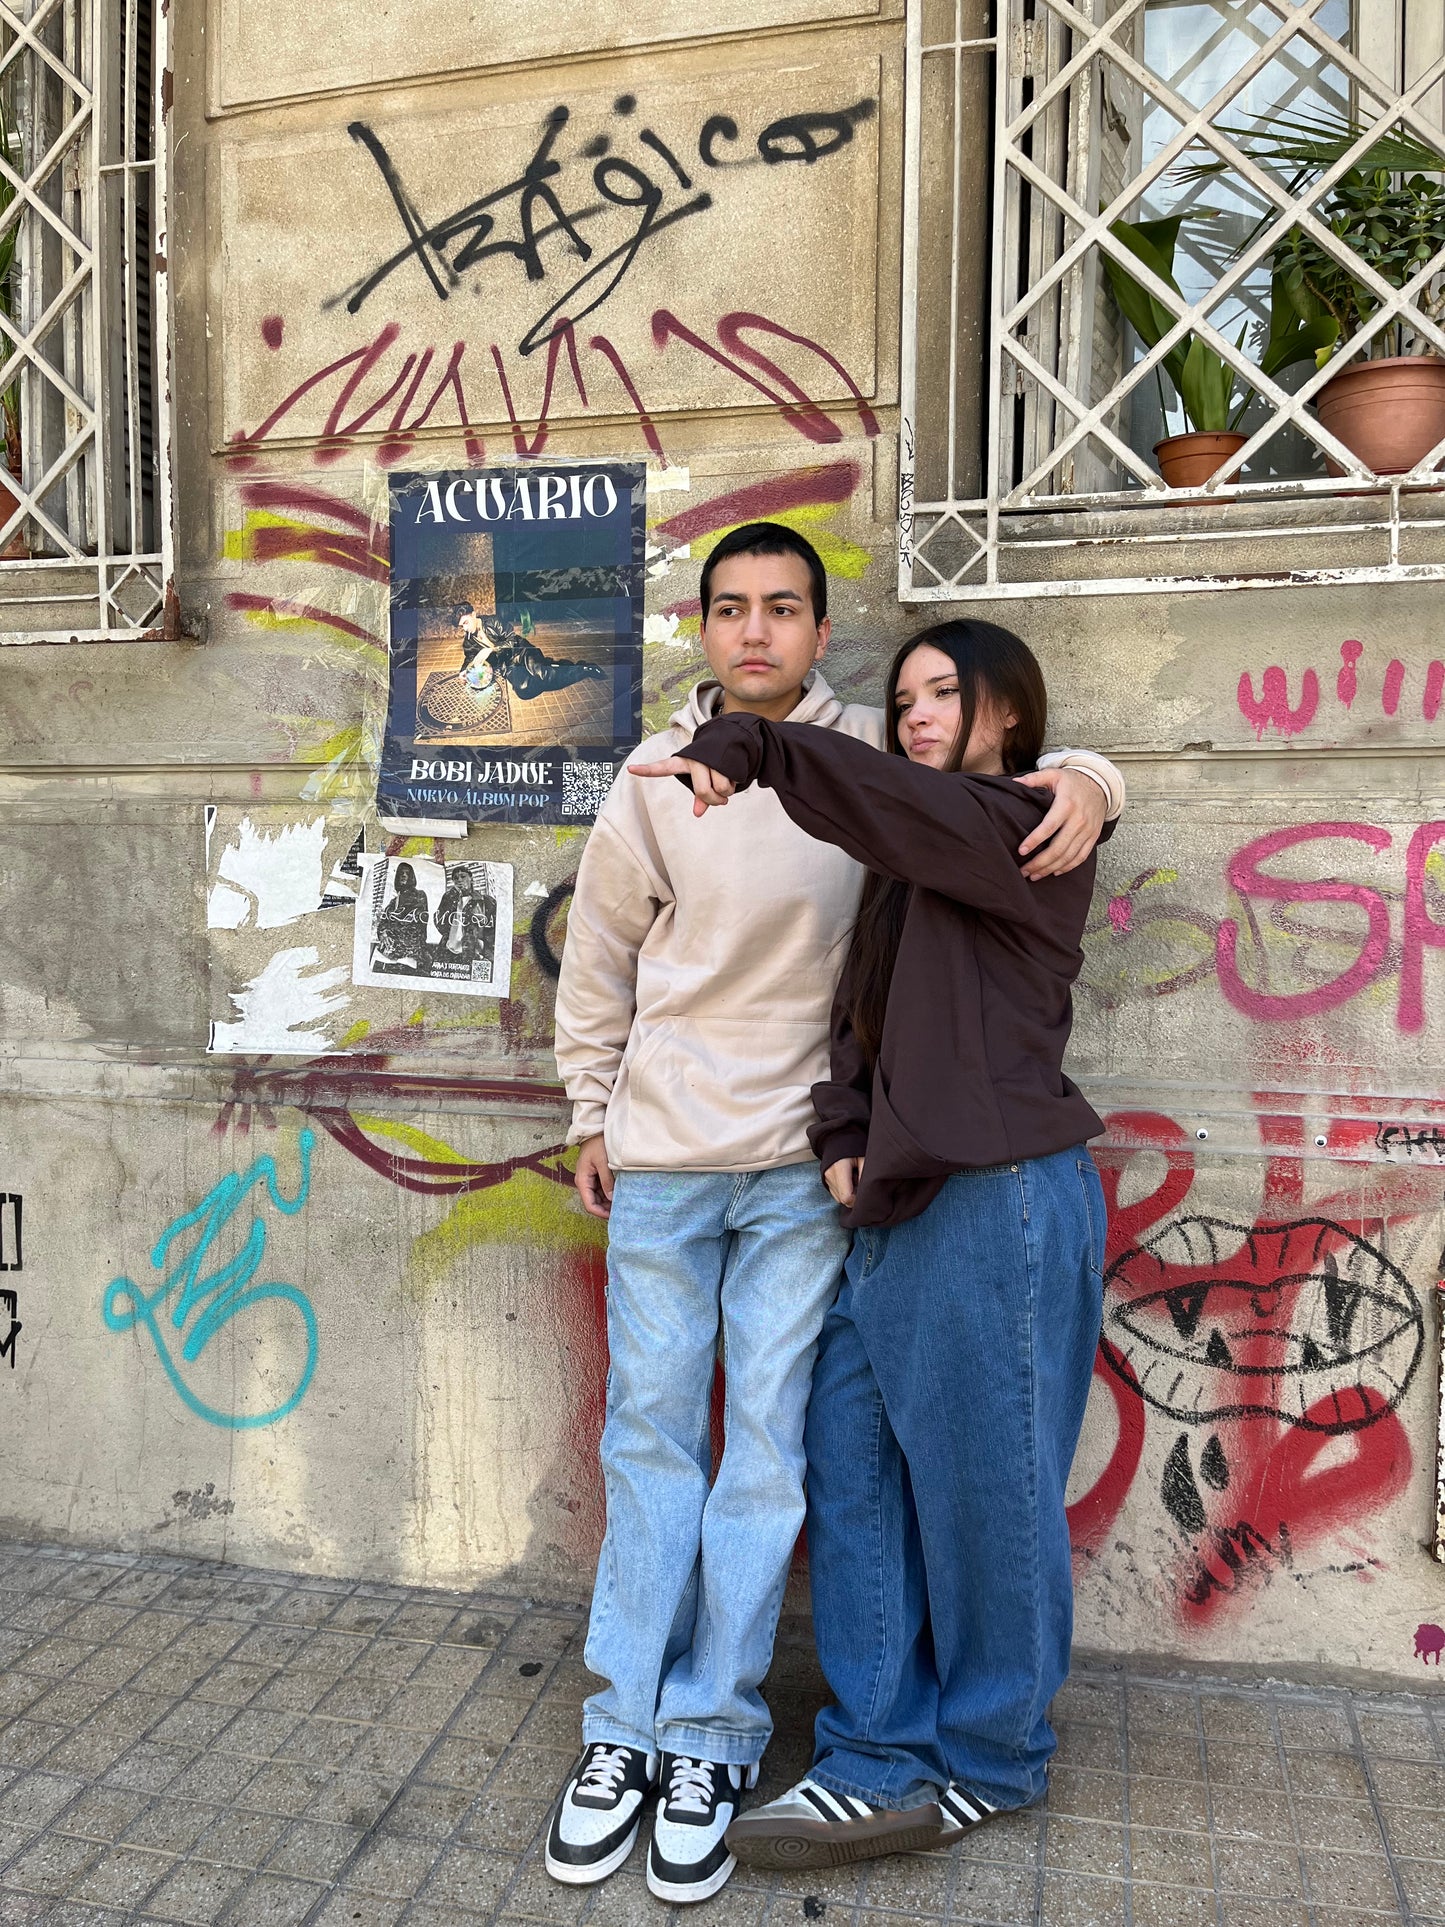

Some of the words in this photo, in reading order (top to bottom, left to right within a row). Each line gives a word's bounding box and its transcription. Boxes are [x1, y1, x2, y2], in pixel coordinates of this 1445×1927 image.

[414, 474, 618, 524] ACUARIO
[409, 759, 473, 782] BOBI
[477, 761, 553, 785] JADUE
[406, 788, 458, 803] NUEVO
[461, 788, 515, 807] ÁLBUM
[518, 793, 550, 808] POP
